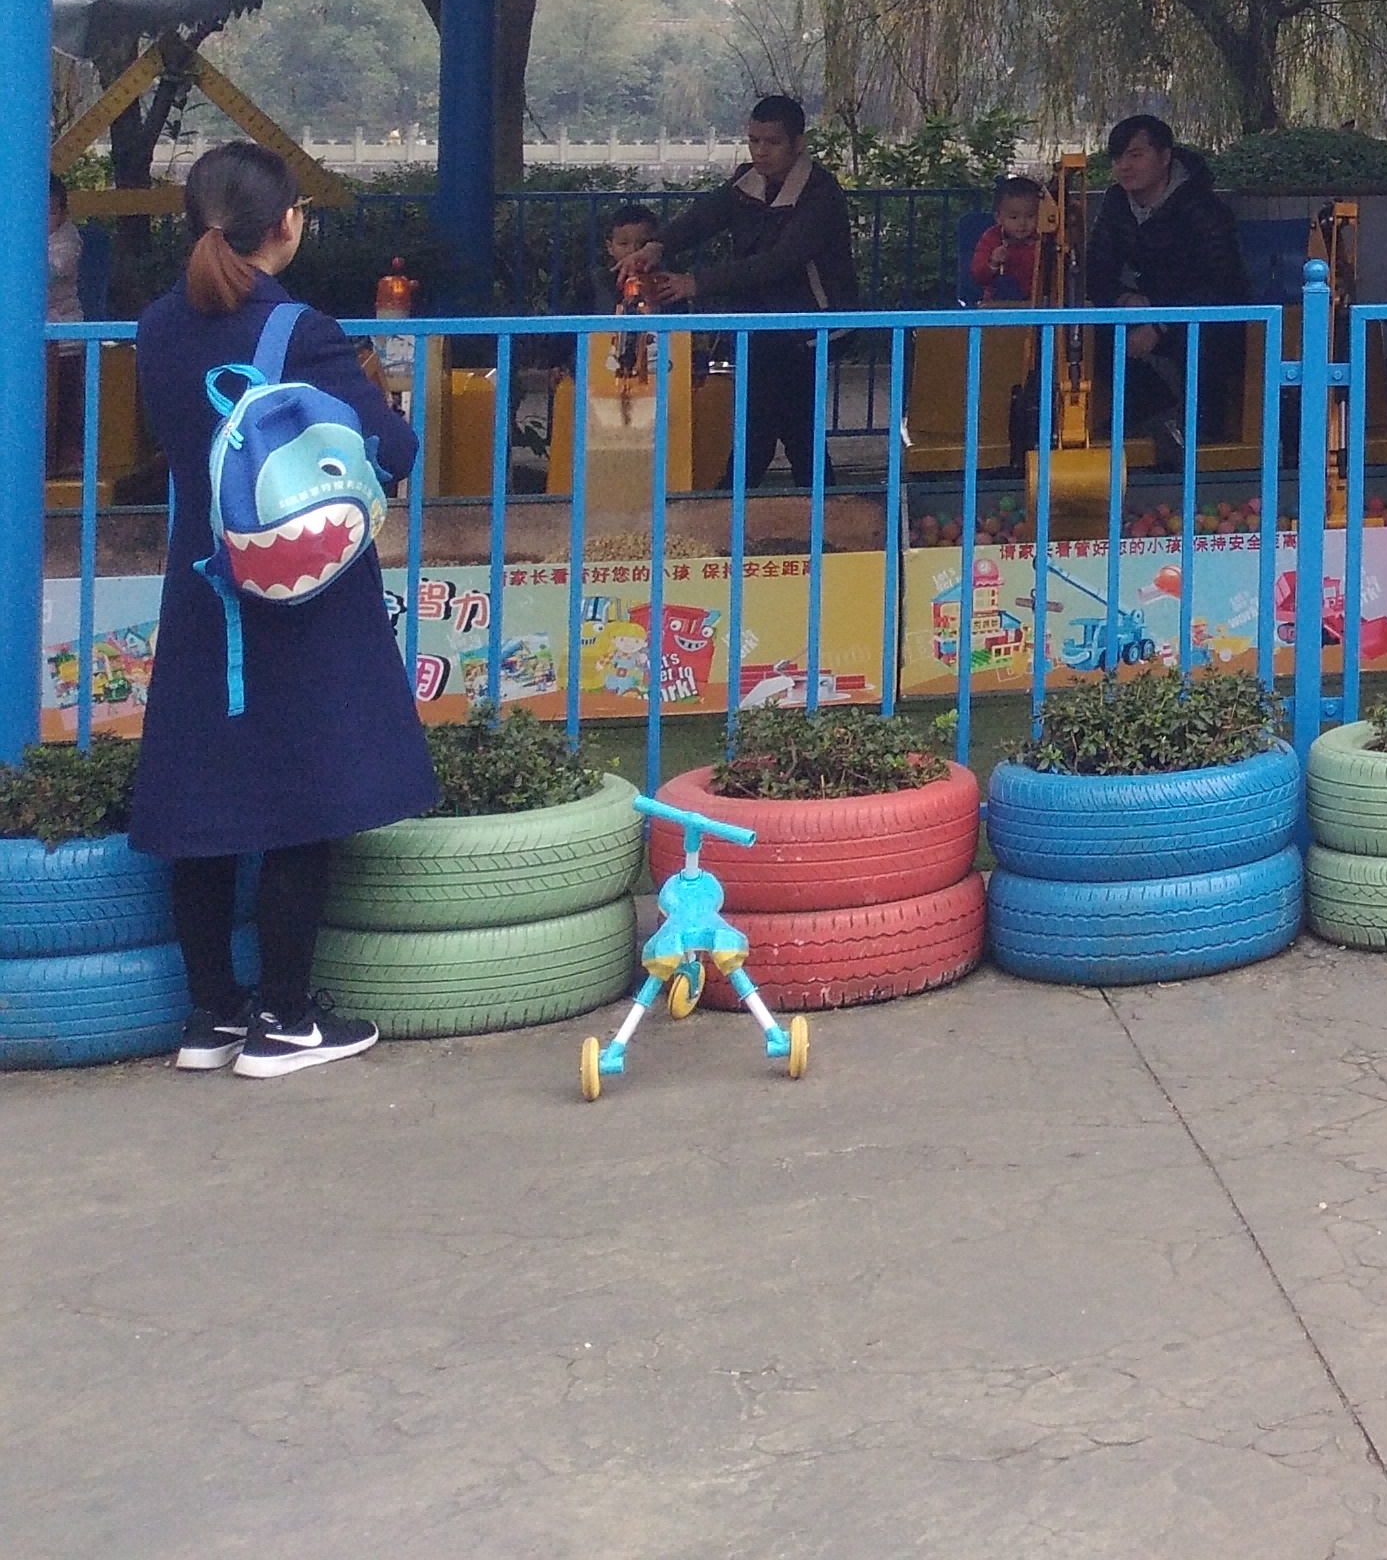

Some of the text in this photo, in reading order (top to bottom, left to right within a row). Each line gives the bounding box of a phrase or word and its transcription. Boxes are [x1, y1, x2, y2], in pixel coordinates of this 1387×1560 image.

[1000, 532, 1298, 561] 请家看管好您的小孩 保持安全离
